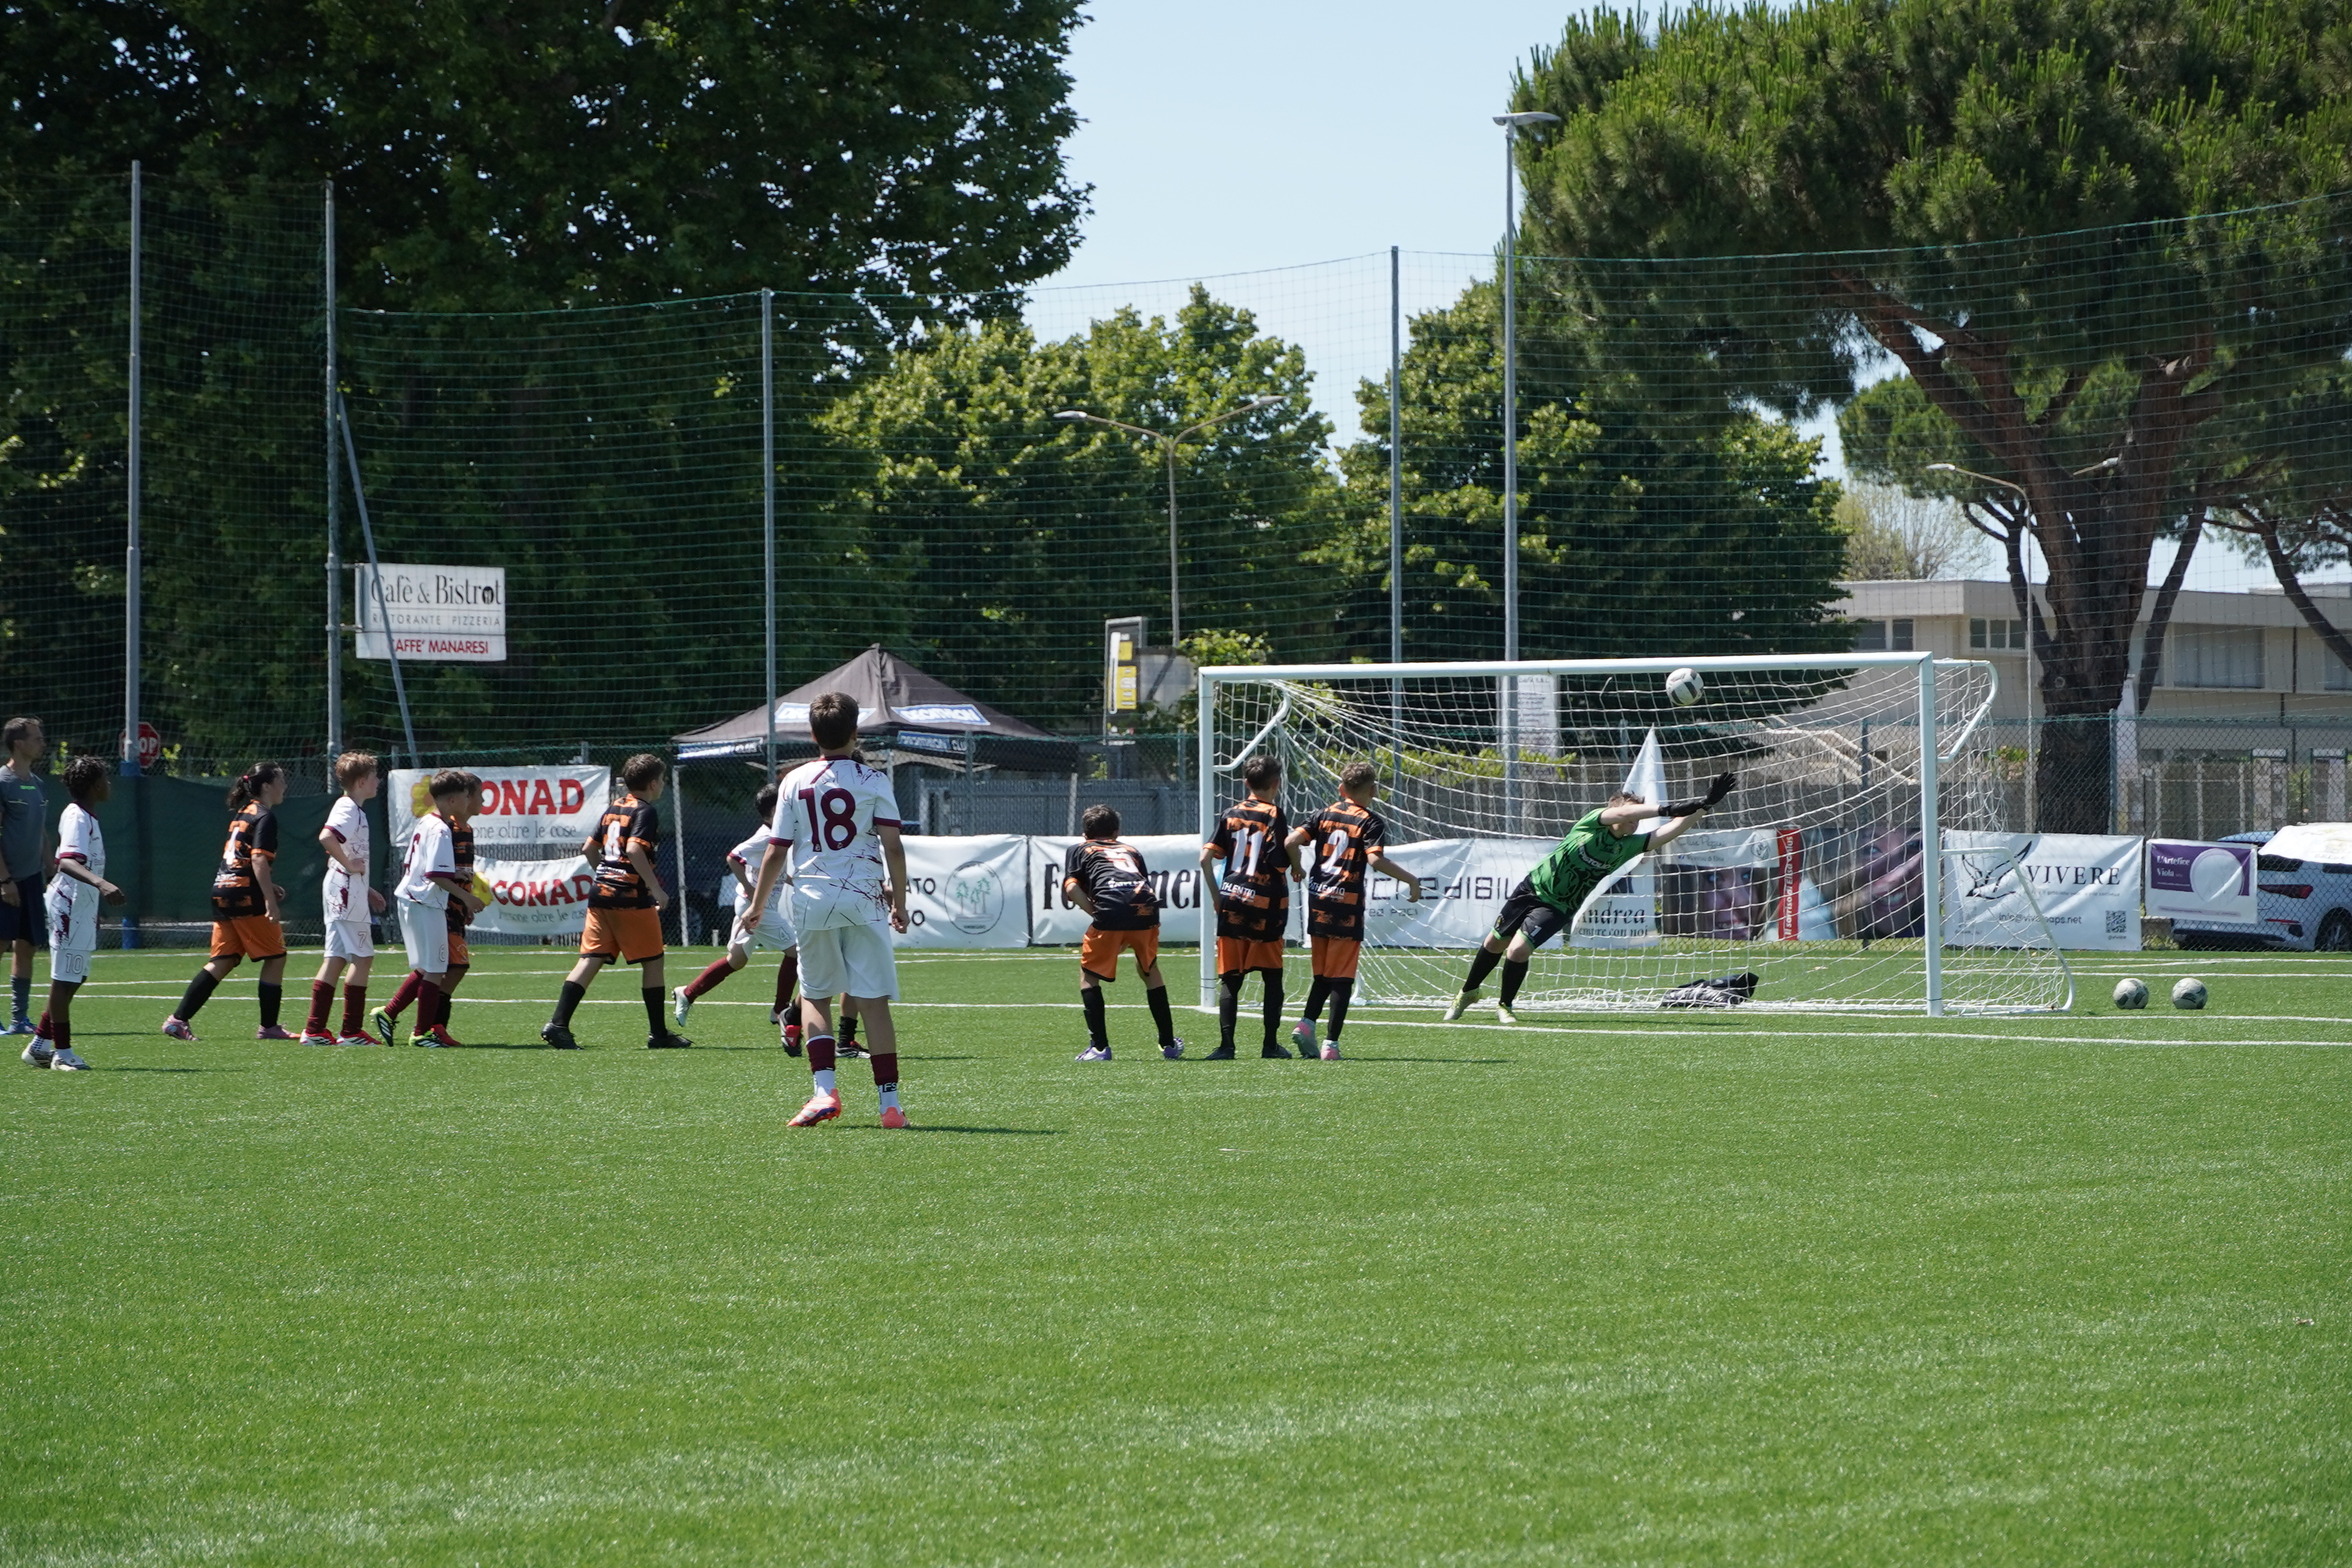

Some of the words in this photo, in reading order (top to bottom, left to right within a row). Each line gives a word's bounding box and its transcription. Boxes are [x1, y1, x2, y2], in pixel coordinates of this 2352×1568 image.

[417, 581, 430, 604] &
[435, 574, 502, 605] Bistrot
[372, 614, 441, 626] RITORANTE
[452, 615, 501, 626] PIZZERIA
[428, 640, 489, 654] MANARESI
[480, 779, 584, 815] ONAD
[534, 820, 545, 837] le
[799, 788, 857, 852] 18
[1232, 828, 1263, 876] 11
[1321, 829, 1349, 875] 2
[2026, 865, 2120, 885] VIVERE
[2157, 868, 2174, 877] Viola
[492, 874, 593, 906] CONAD
[1999, 912, 2082, 926] info@viveaps.net
[358, 931, 366, 948] 7
[1578, 927, 1607, 940] empre
[1609, 928, 1627, 937] con
[1630, 925, 1648, 938] noi
[66, 953, 83, 974] 10
